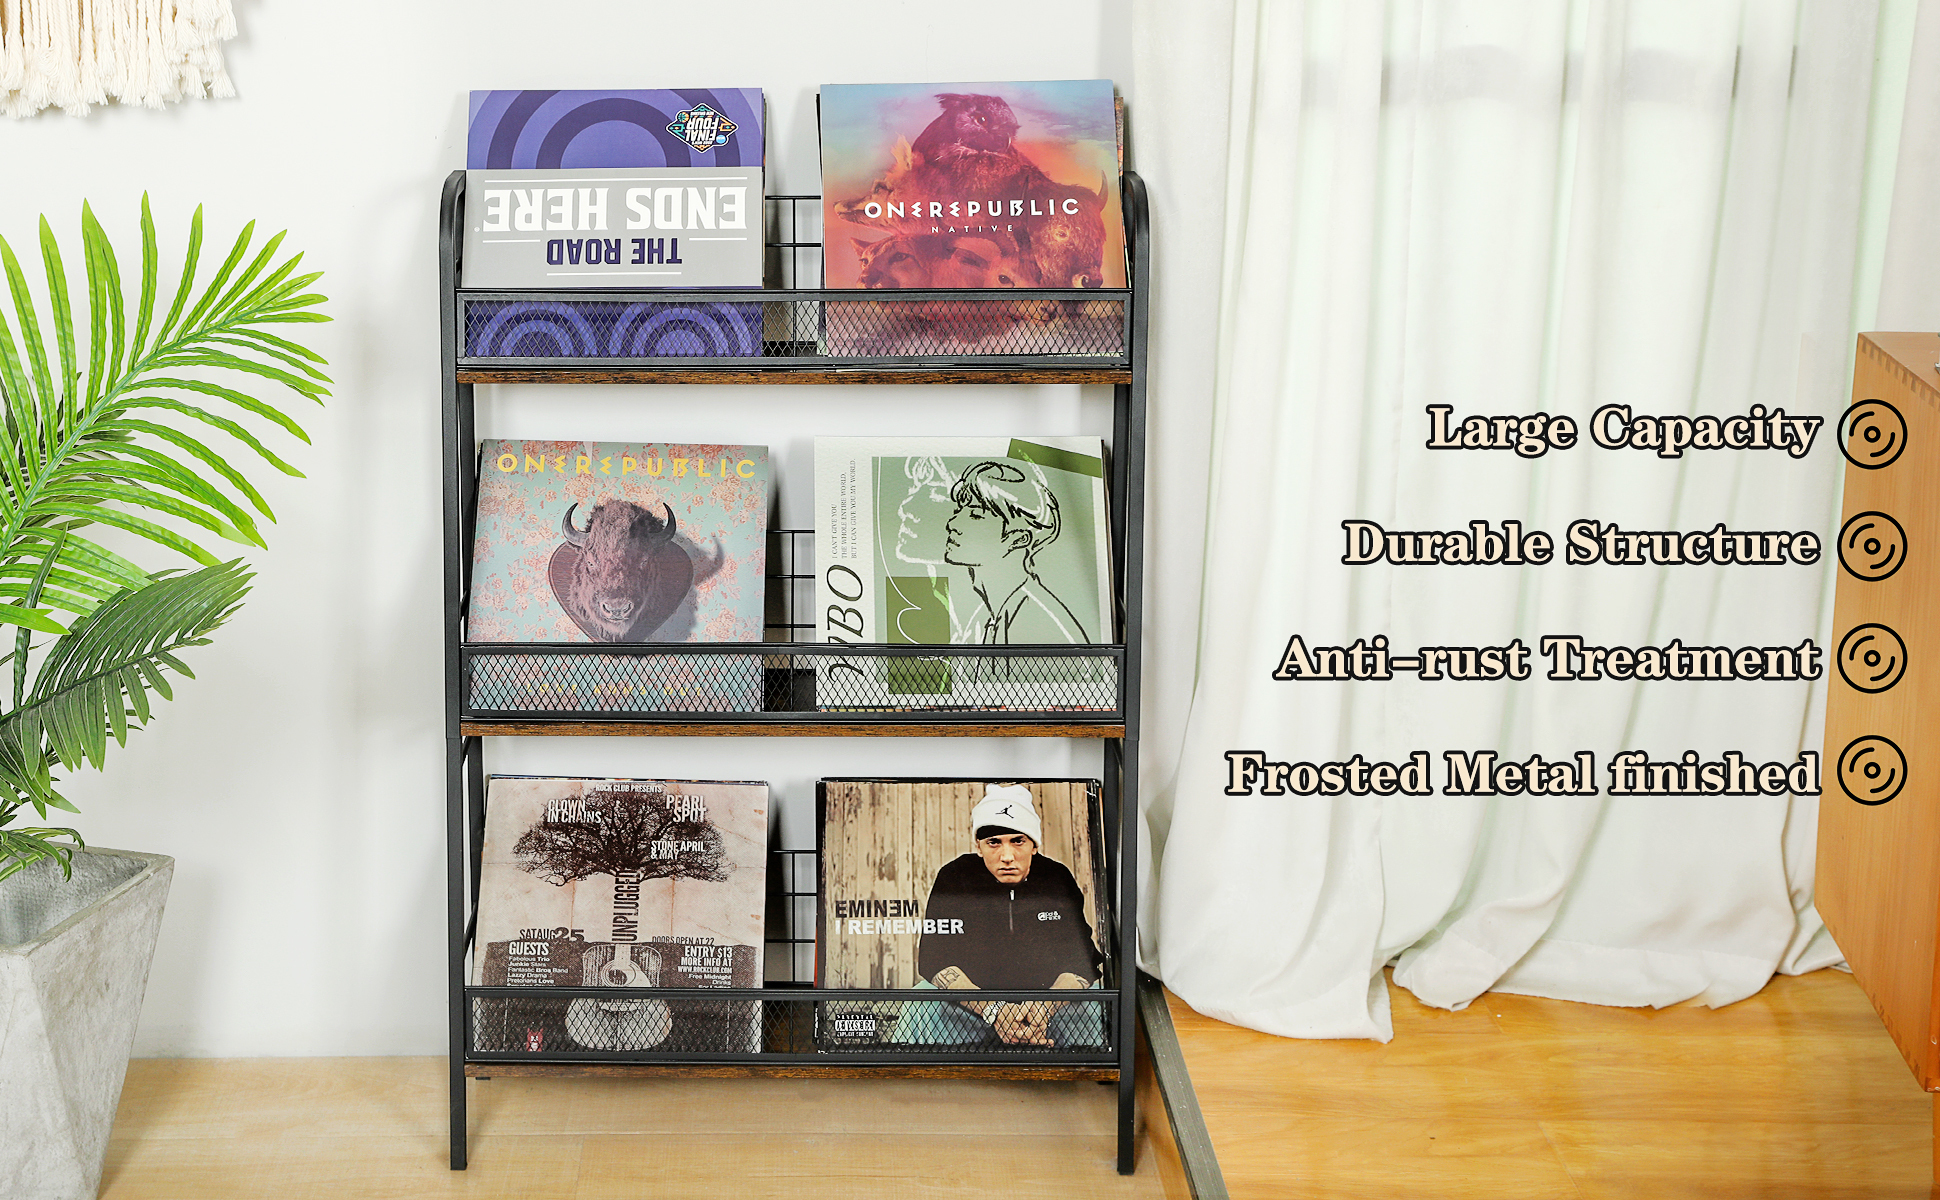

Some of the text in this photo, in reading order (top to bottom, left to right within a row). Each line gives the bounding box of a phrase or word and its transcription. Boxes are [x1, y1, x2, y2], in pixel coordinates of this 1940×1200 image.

[687, 117, 719, 130] FOUR
[685, 129, 717, 141] FINAL
[482, 186, 748, 232] ENDS HERE
[864, 198, 1079, 219] ONEREPUBLIC
[931, 224, 1014, 234] NATIVE
[546, 238, 683, 265] THE ROAD
[497, 453, 755, 479] ONEREPUBLIC
[850, 484, 856, 495] MY
[596, 784, 662, 793] ROCK CLUB PRESENTS
[548, 799, 586, 811] CLOWN
[666, 794, 706, 811] PEARL
[547, 810, 601, 824] IN CHAINS
[672, 808, 707, 823] SPOT
[651, 841, 705, 852] STONE APRIL
[660, 850, 679, 860] MAY
[612, 871, 641, 941] UNPLUGGED
[835, 899, 919, 918] EMINEM
[835, 919, 964, 935] I REMEMBER
[508, 941, 550, 956] GUESTS
[684, 945, 733, 958] ENTRY $13
[681, 956, 733, 967] MORE INFO AT
